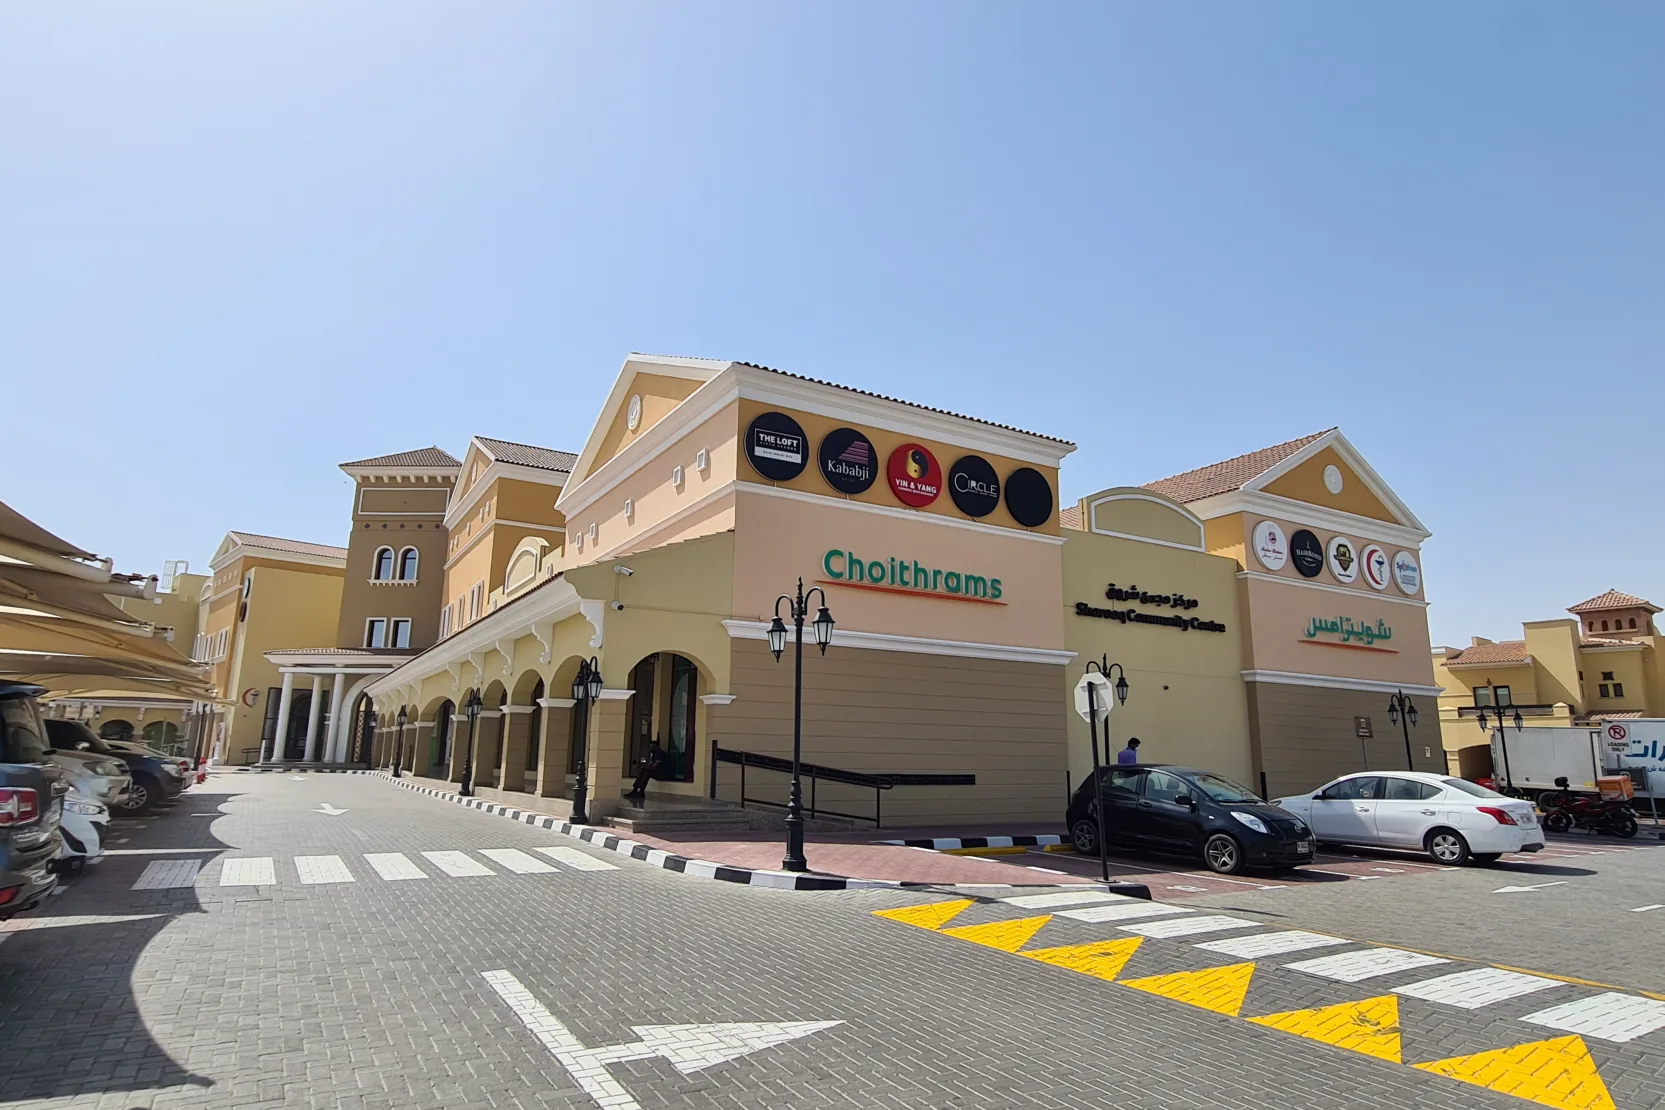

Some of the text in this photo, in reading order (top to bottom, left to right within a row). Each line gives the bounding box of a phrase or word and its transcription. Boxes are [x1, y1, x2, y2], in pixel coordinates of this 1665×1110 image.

[758, 433, 798, 447] THE LOFT
[827, 459, 869, 481] Kababji
[895, 478, 908, 488] YIN
[917, 483, 937, 494] YANG
[954, 472, 998, 495] CIRCLE
[821, 549, 1002, 600] Choithrams
[1105, 582, 1199, 610] مركز مجمع شروق
[1126, 608, 1190, 632] Community
[1189, 617, 1227, 633] Centre
